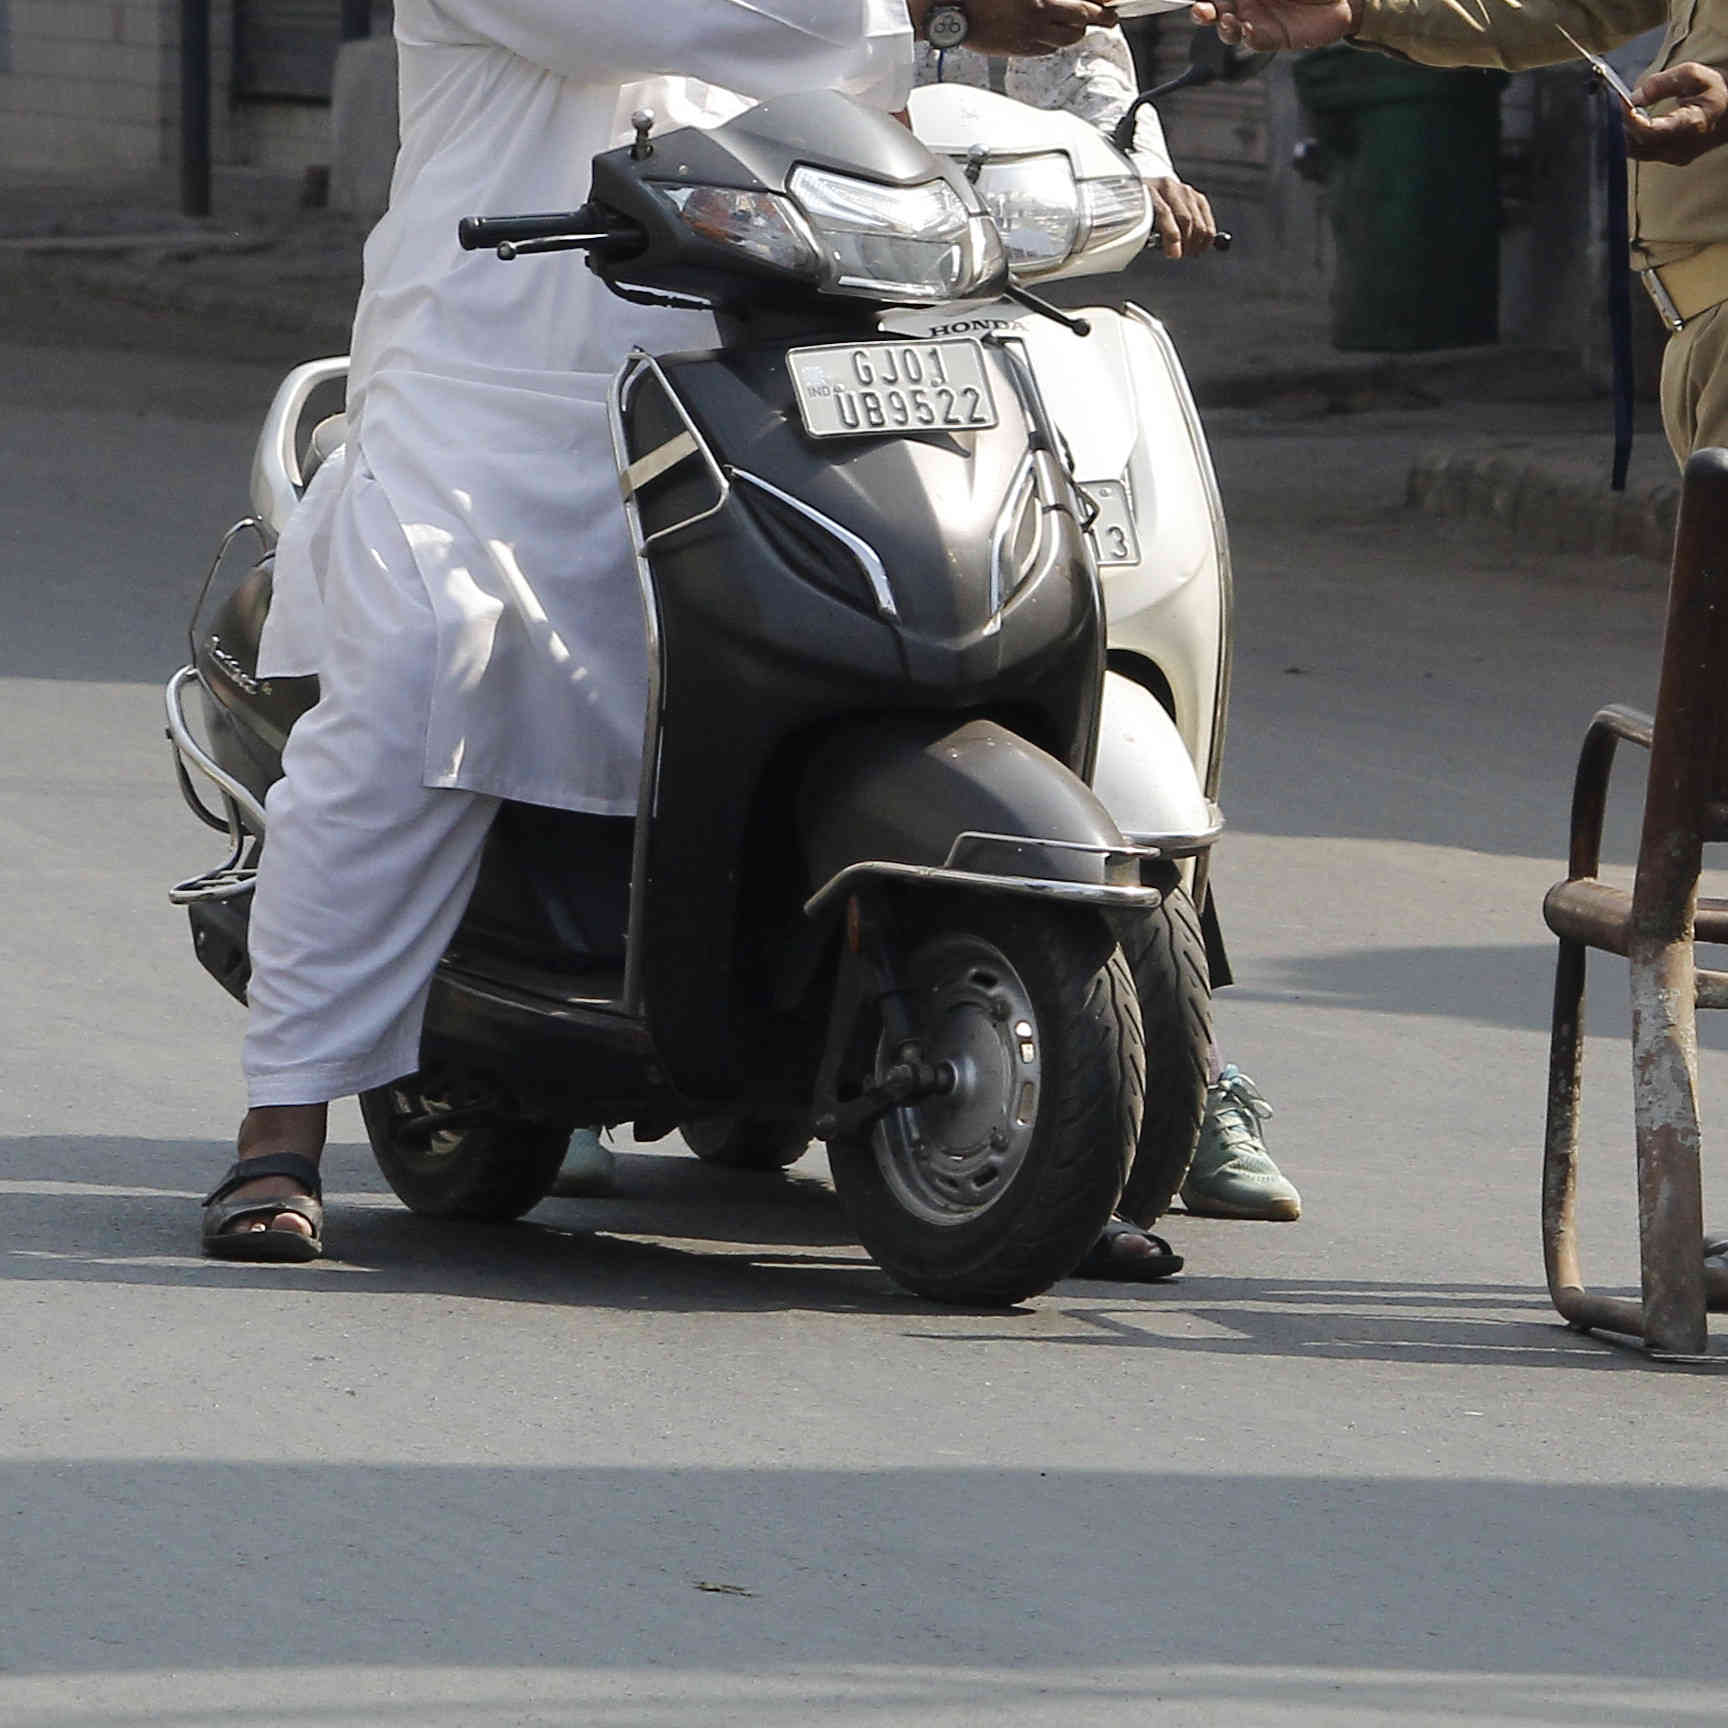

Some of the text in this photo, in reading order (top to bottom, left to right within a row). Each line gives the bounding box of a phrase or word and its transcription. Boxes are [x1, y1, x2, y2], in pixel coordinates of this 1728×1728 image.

[928, 319, 1030, 337] HONDA
[852, 347, 947, 385] GJ01
[835, 387, 988, 428] UB9522
